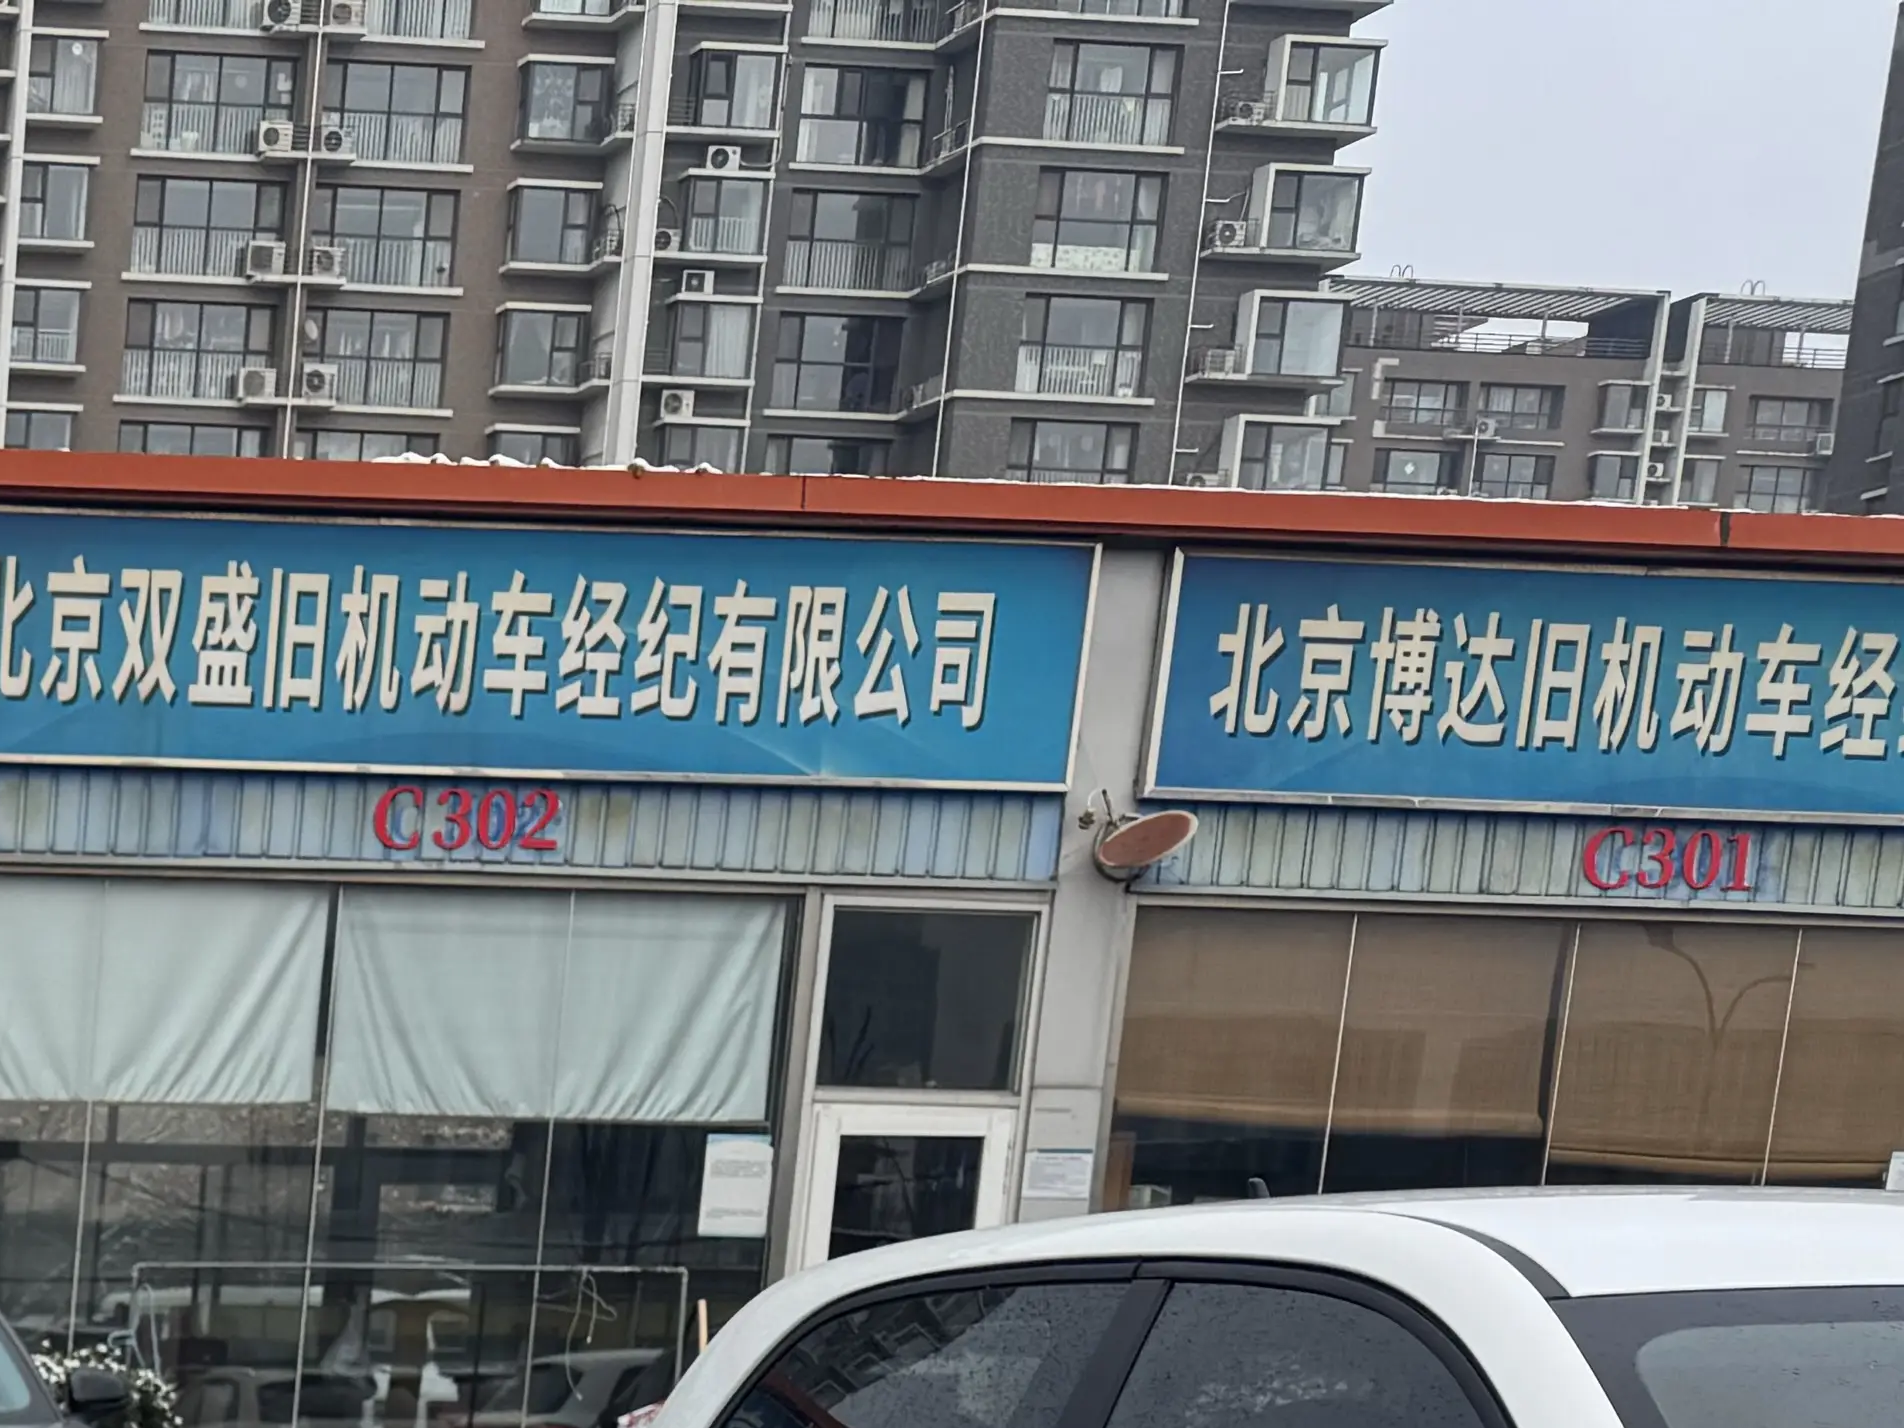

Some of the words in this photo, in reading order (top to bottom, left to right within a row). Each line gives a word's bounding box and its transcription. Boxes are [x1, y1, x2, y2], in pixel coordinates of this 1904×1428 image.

[1209, 602, 1904, 757] 北京博达旧机动车经
[373, 786, 560, 850] C302
[1582, 828, 1753, 892] C301
